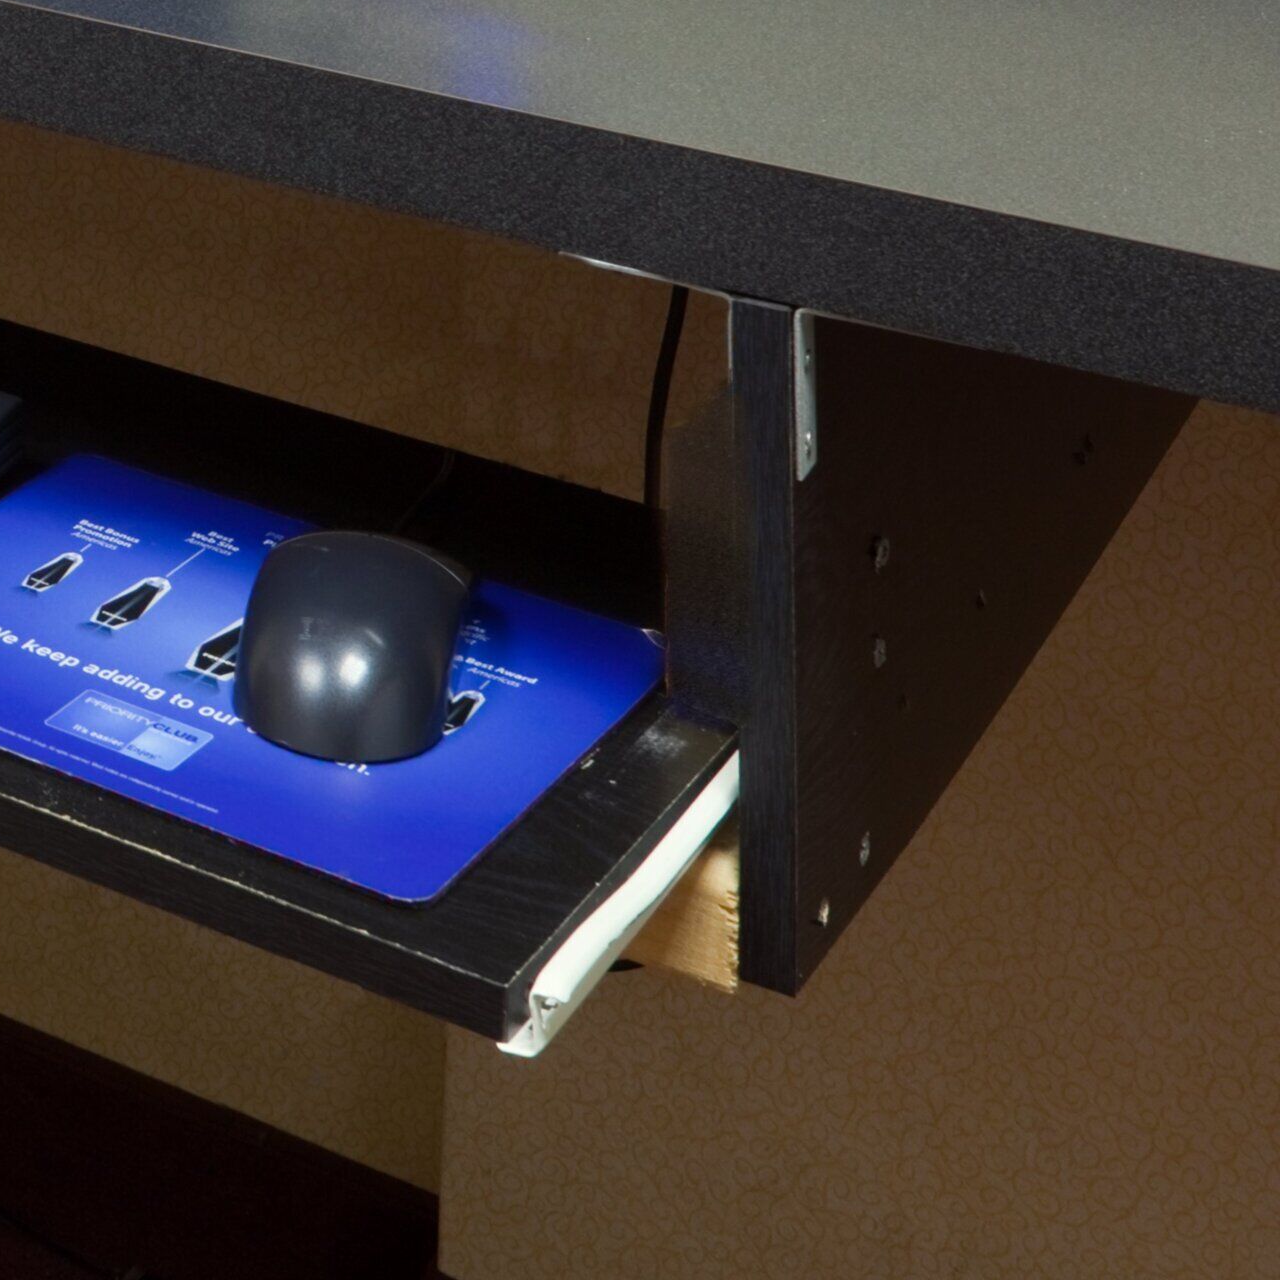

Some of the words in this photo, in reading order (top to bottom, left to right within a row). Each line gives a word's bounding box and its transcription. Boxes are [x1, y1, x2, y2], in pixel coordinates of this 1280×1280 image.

[70, 531, 118, 551] Americas
[73, 524, 132, 549] Promotion
[79, 519, 104, 534] Best
[105, 525, 141, 545] Bonus
[191, 531, 216, 544] Web
[217, 541, 240, 553] Site
[208, 530, 235, 543] Best
[184, 537, 233, 556] Americas
[465, 656, 495, 671] Best
[494, 666, 539, 685] Award
[466, 667, 521, 688] Americas
[21, 638, 80, 668] keep
[83, 661, 167, 702] adding
[170, 691, 194, 710] to
[198, 703, 243, 727] our
